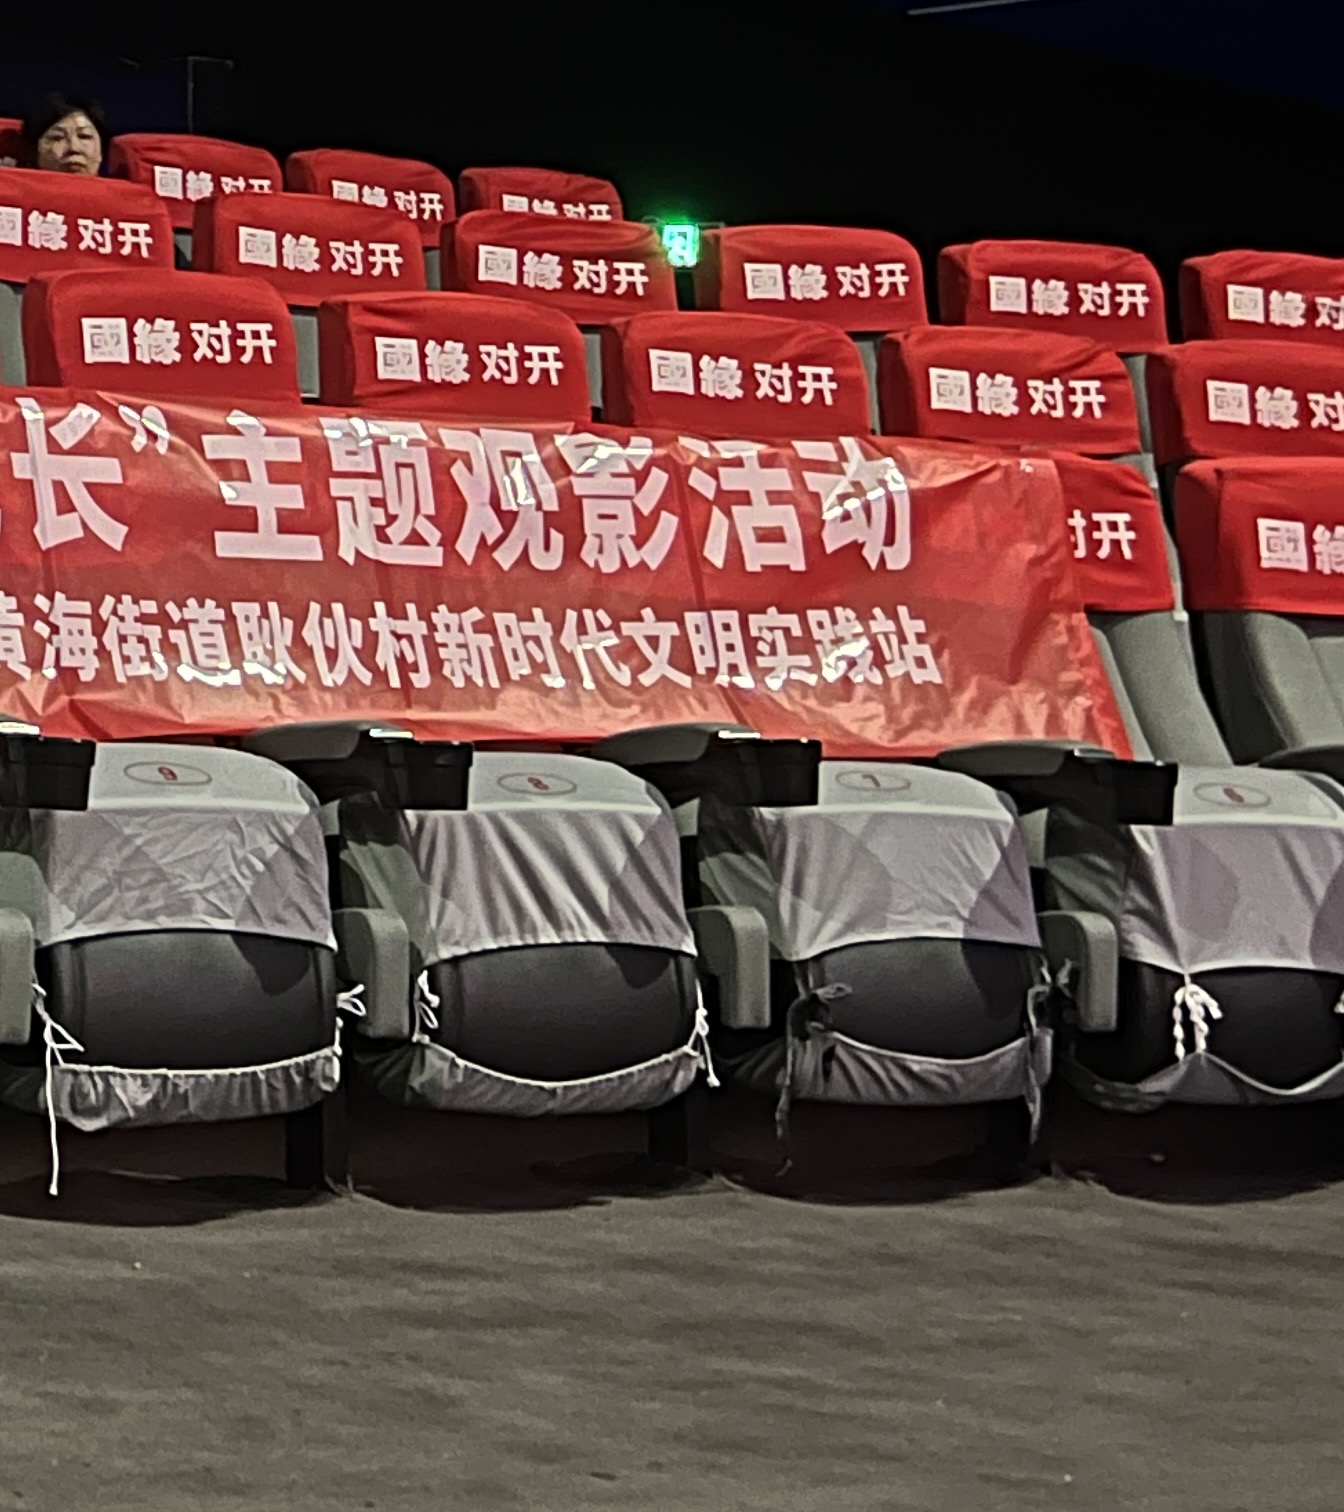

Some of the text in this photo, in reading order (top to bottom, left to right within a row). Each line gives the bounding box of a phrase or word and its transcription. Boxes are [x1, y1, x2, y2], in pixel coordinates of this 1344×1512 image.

[394, 190, 444, 221] 对开
[78, 218, 153, 258] 对开
[329, 240, 403, 276] 对开
[573, 259, 649, 296] 对开
[835, 263, 909, 297] 对开
[1078, 281, 1149, 316] 对开
[190, 320, 277, 363] 对开
[479, 343, 563, 385] 对开
[754, 363, 837, 405] 对开
[1027, 378, 1106, 418] 对开
[157, 766, 178, 782] 9
